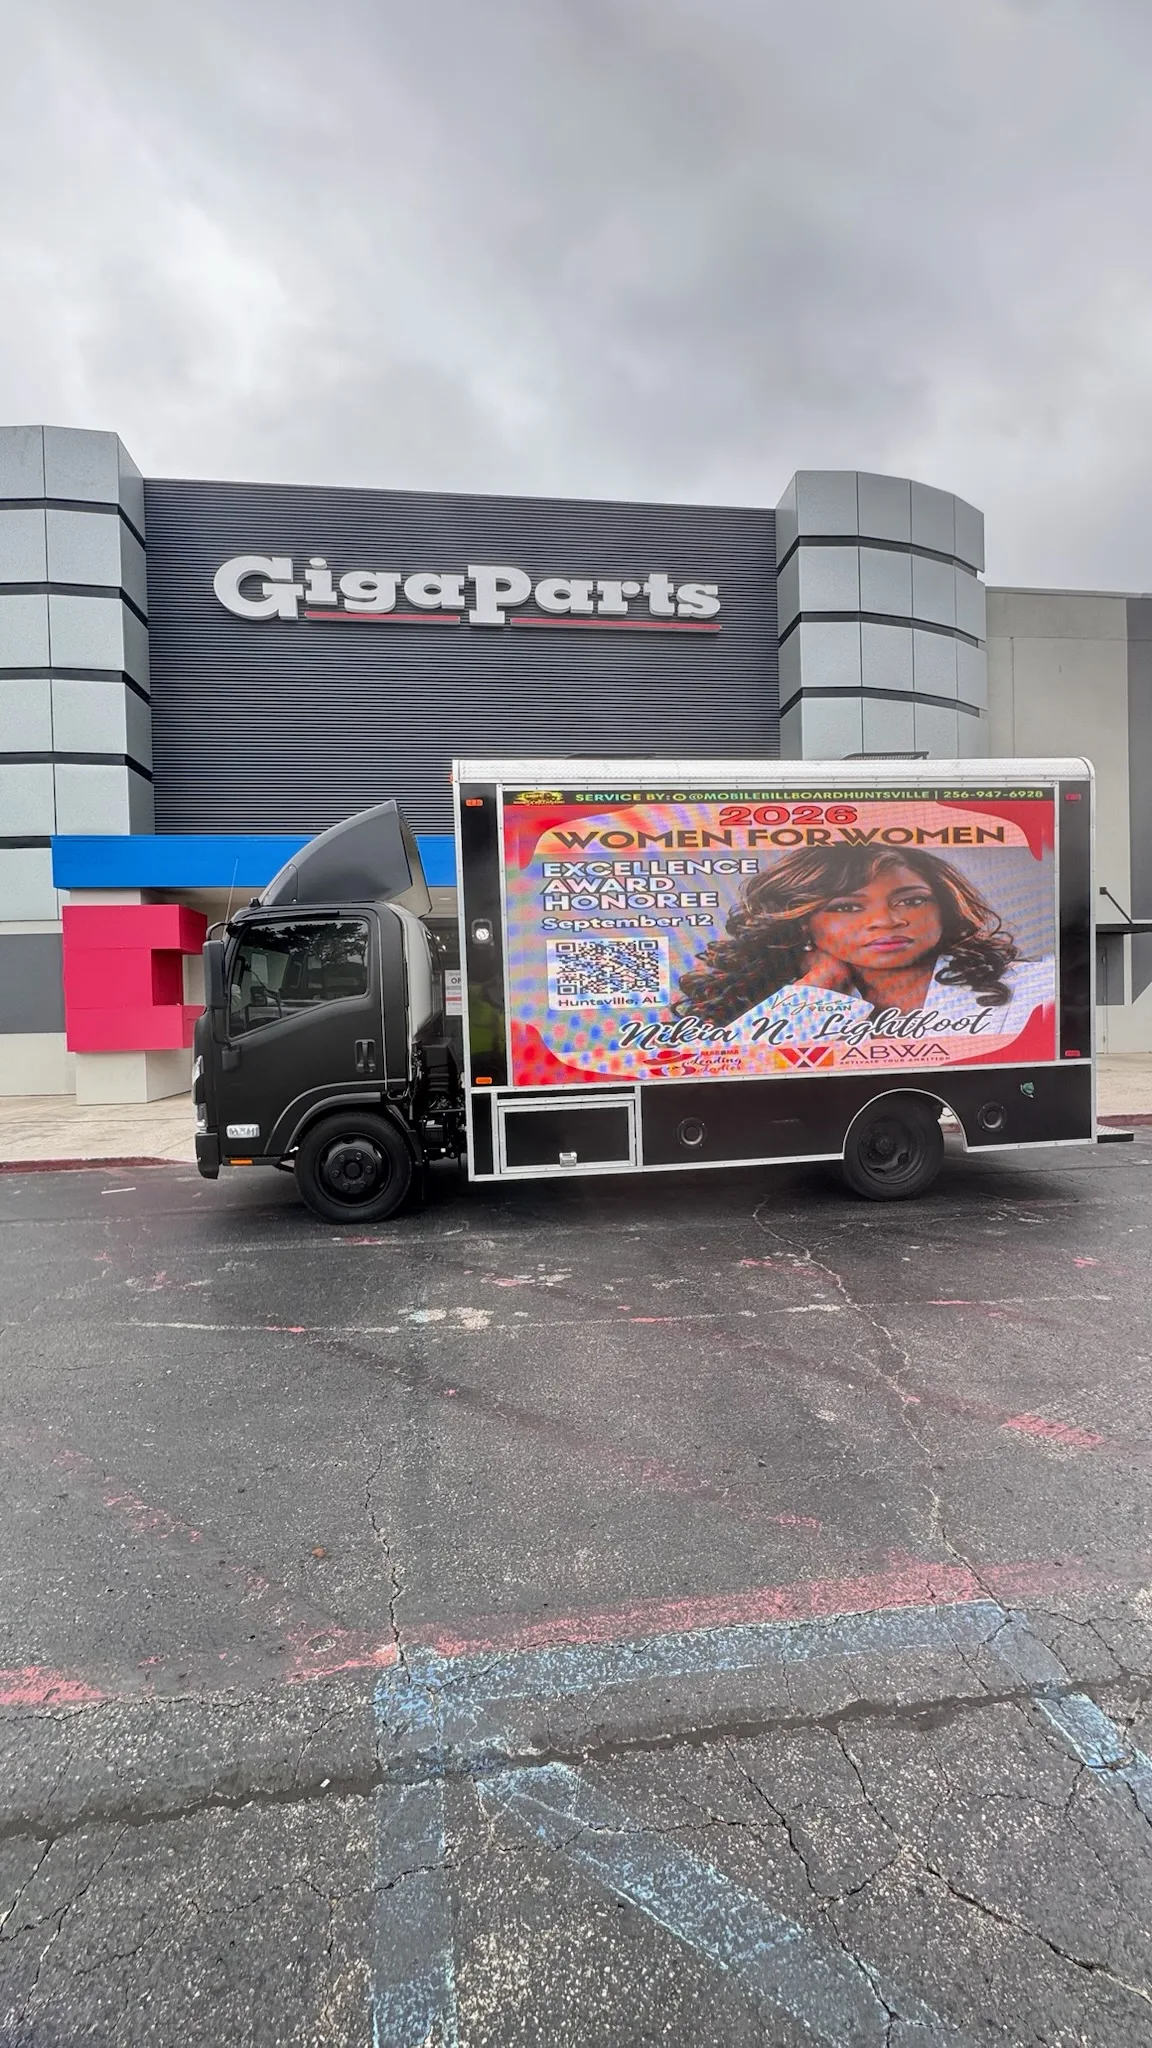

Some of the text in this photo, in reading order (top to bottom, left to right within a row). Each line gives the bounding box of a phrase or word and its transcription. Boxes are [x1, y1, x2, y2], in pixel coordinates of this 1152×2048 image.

[212, 555, 721, 625] GigaParts
[575, 793, 641, 802] SERVICE
[647, 793, 670, 801] BY:
[943, 790, 1043, 799] 256-947-6928
[719, 805, 858, 826] 2026
[552, 826, 1004, 849] WOMEN FOR WOMEN
[542, 859, 759, 877] EXCELLENCE
[540, 876, 675, 895] AWARD
[543, 892, 719, 911] HONOREE
[542, 914, 713, 932] September 12
[558, 996, 663, 1007] Huntsville, AL
[620, 1007, 994, 1050] Nikia N. Lightfoot
[841, 1043, 949, 1060] ABWA
